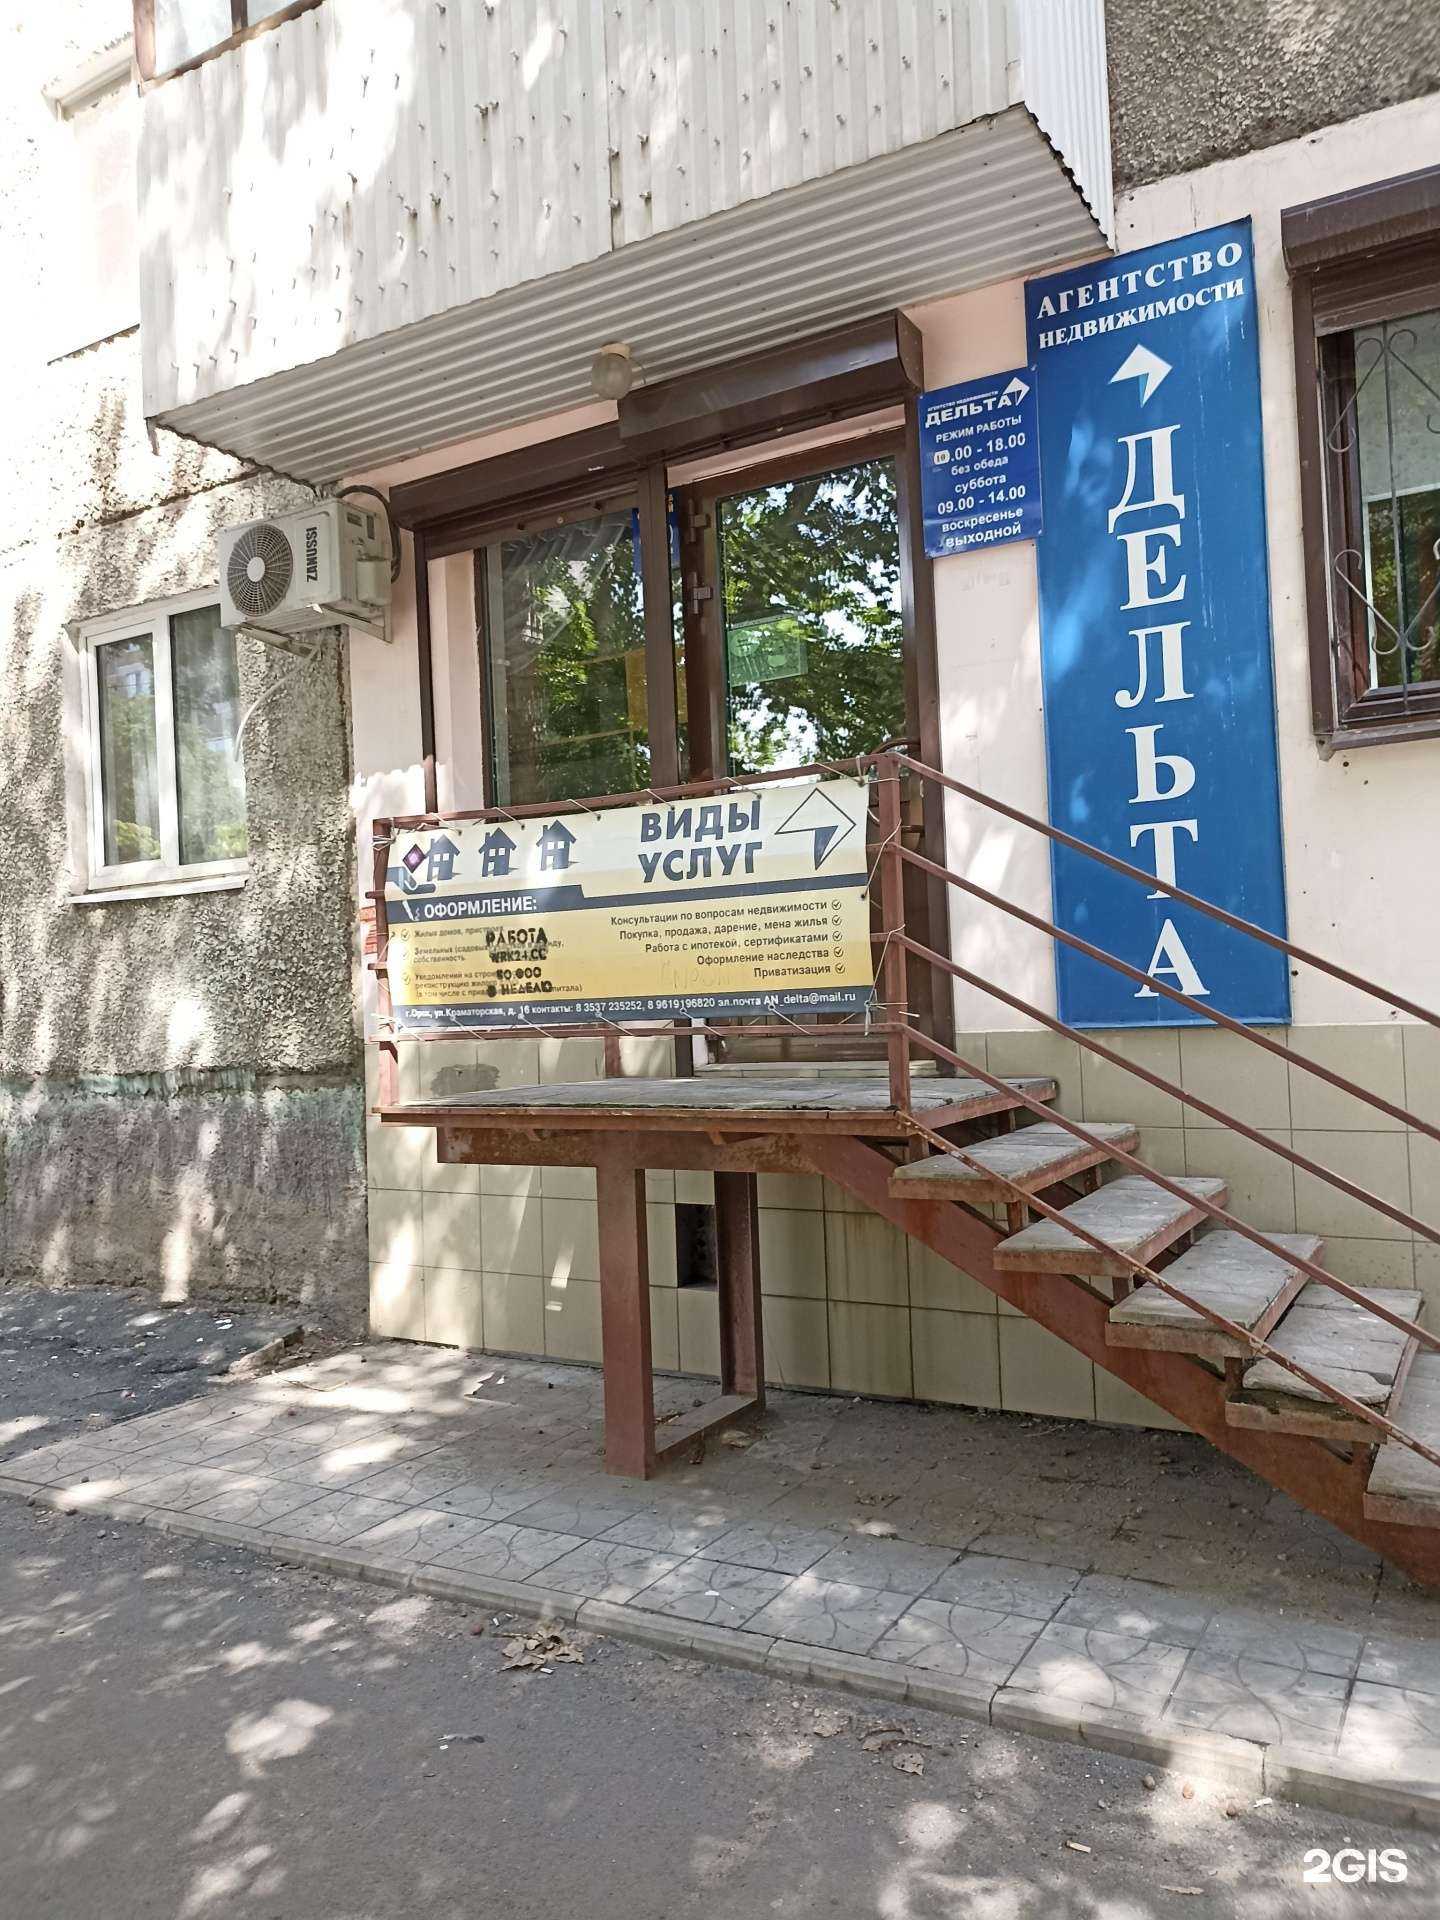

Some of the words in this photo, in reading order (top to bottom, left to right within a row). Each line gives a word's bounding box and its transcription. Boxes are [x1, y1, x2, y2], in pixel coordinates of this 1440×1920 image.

[1036, 242, 1243, 320] АГЕНТСТВО
[1038, 278, 1245, 349] НЕДВИЖИМОСТИ
[925, 395, 1012, 428] ДЕЛЬТА
[936, 427, 974, 443] РЕЖИМ
[977, 415, 1022, 434] РАБОТЫ
[987, 432, 1026, 453] 18.00
[951, 465, 970, 476] без
[974, 456, 1009, 471] обеда
[955, 474, 1007, 494] суббота
[937, 496, 974, 515] 09.00
[988, 485, 1026, 503] 14.00
[942, 507, 1023, 532] воскресенье
[945, 521, 1021, 548] выходной
[306, 526, 318, 583] ZANUSSI
[1108, 424, 1210, 998] ДЕЛЬТА
[641, 800, 761, 843] ВИДЫ
[638, 841, 762, 883] УСЛУГ
[424, 895, 537, 919] ОФОРМЛЕНИЕ:
[611, 913, 678, 926] Консультации
[680, 912, 693, 921] по
[695, 907, 744, 920] вопросам
[747, 901, 828, 916] недвижимости
[486, 927, 548, 947] РАБОТА
[619, 930, 662, 941] Покупка,
[665, 926, 711, 938] продажа,
[714, 921, 761, 934] дарение,
[764, 919, 791, 931] мена
[794, 916, 828, 927] жилья
[645, 943, 679, 953] Работа
[744, 932, 828, 948] сертификатами
[697, 952, 764, 966] Оформление
[767, 949, 829, 963] наследства
[754, 964, 831, 979] Приватизация
[501, 980, 553, 996] НЕДЕЛЮ
[519, 1005, 530, 1015] 16
[532, 1003, 574, 1014] контакты:
[575, 1003, 582, 1012] 8
[584, 1002, 606, 1012] 3537
[609, 1001, 645, 1012] 235252,
[647, 1000, 654, 1009] 8
